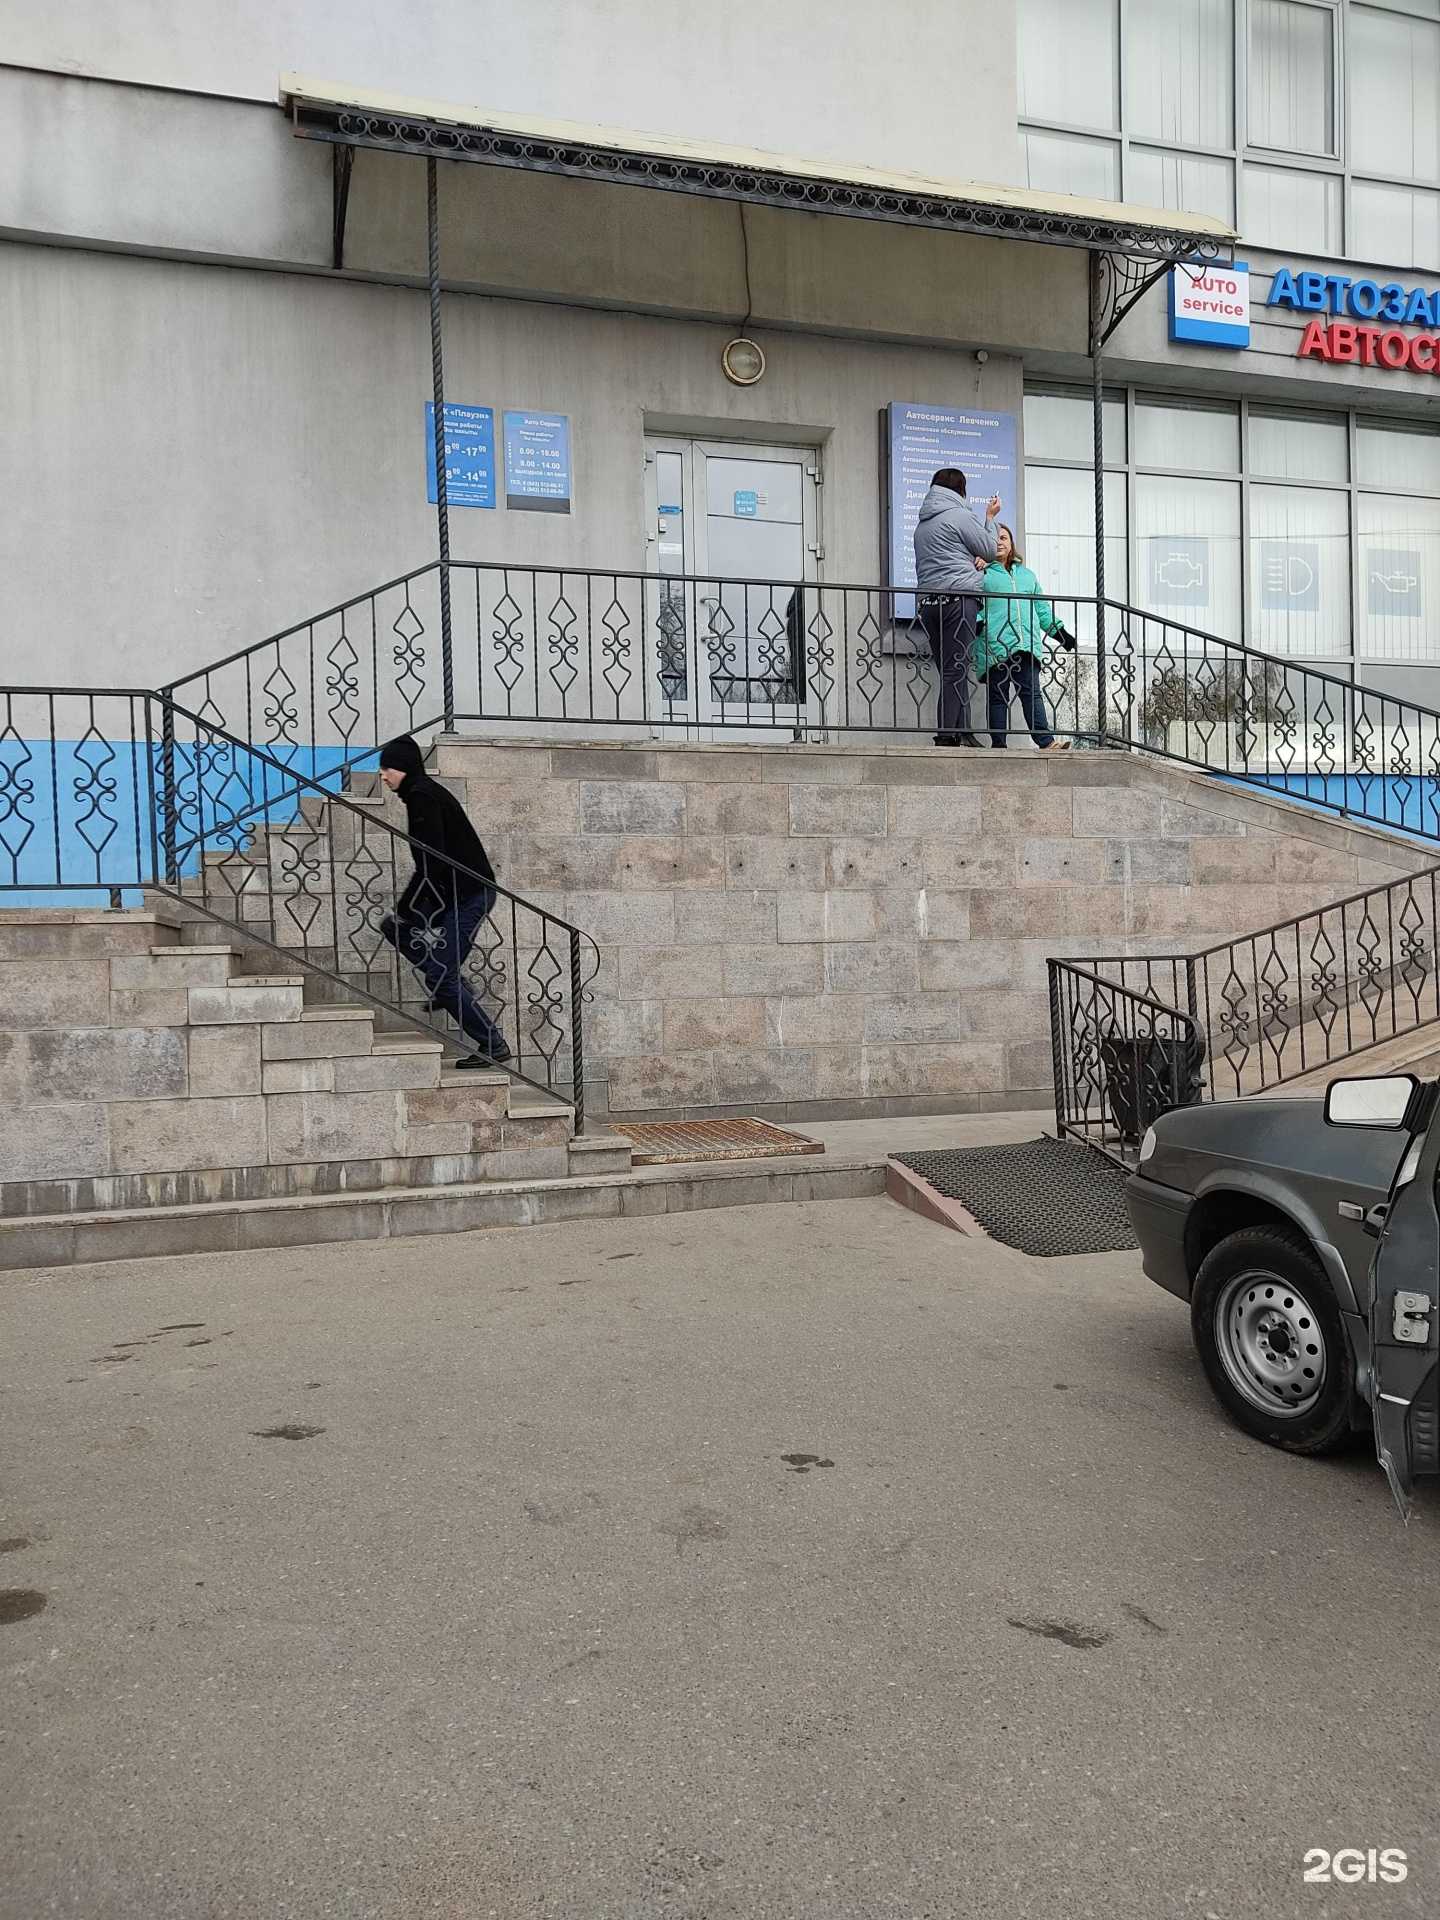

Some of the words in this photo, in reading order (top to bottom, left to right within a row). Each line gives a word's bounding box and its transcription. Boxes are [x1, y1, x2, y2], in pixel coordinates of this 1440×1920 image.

[1191, 276, 1237, 295] AUTO
[1183, 298, 1244, 316] service
[1267, 268, 1440, 328] АВТОЗА
[1297, 320, 1440, 374] АВТОС
[905, 410, 955, 423] Автосервис
